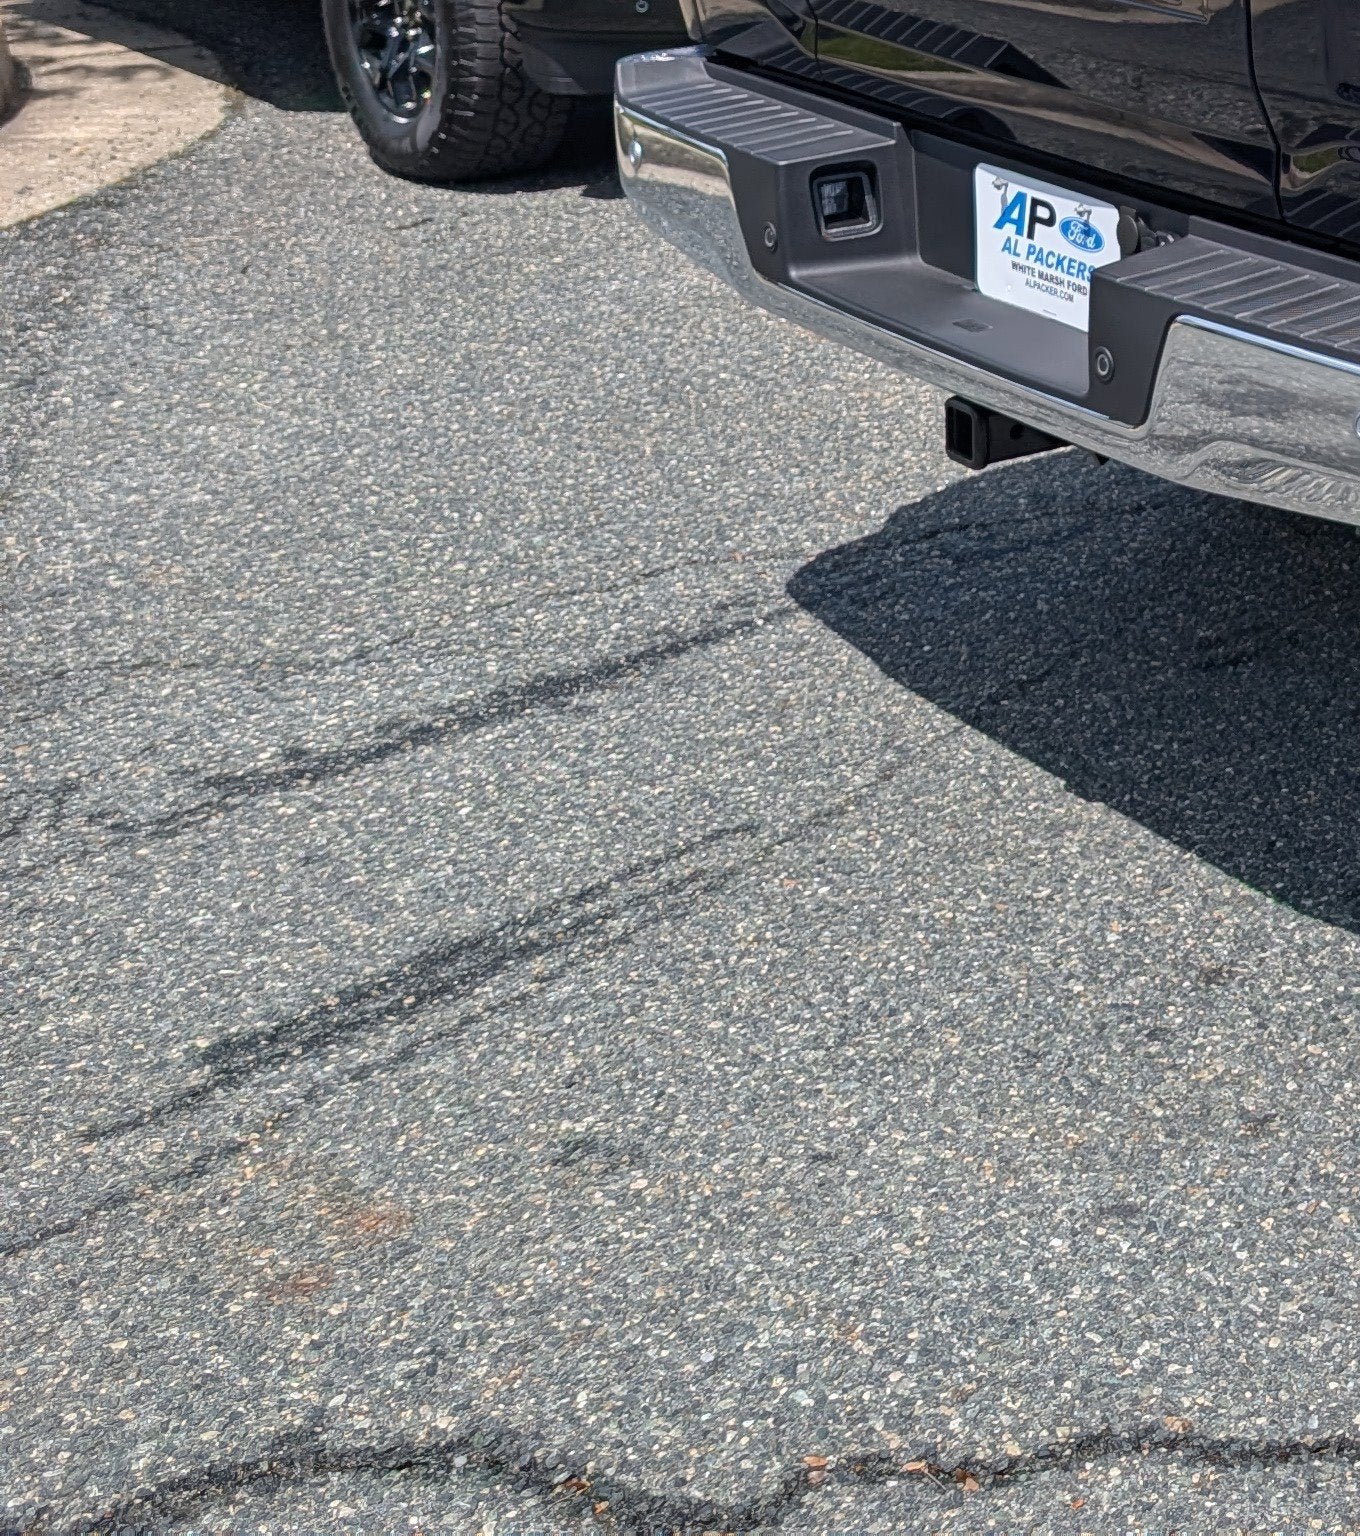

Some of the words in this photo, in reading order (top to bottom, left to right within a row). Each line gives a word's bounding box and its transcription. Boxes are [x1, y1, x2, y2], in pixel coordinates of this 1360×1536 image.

[993, 190, 1057, 241] AP
[1001, 236, 1021, 257] AL
[1011, 260, 1036, 277] WHITE
[1038, 270, 1065, 288] MARSH
[1067, 280, 1088, 296] FORD
